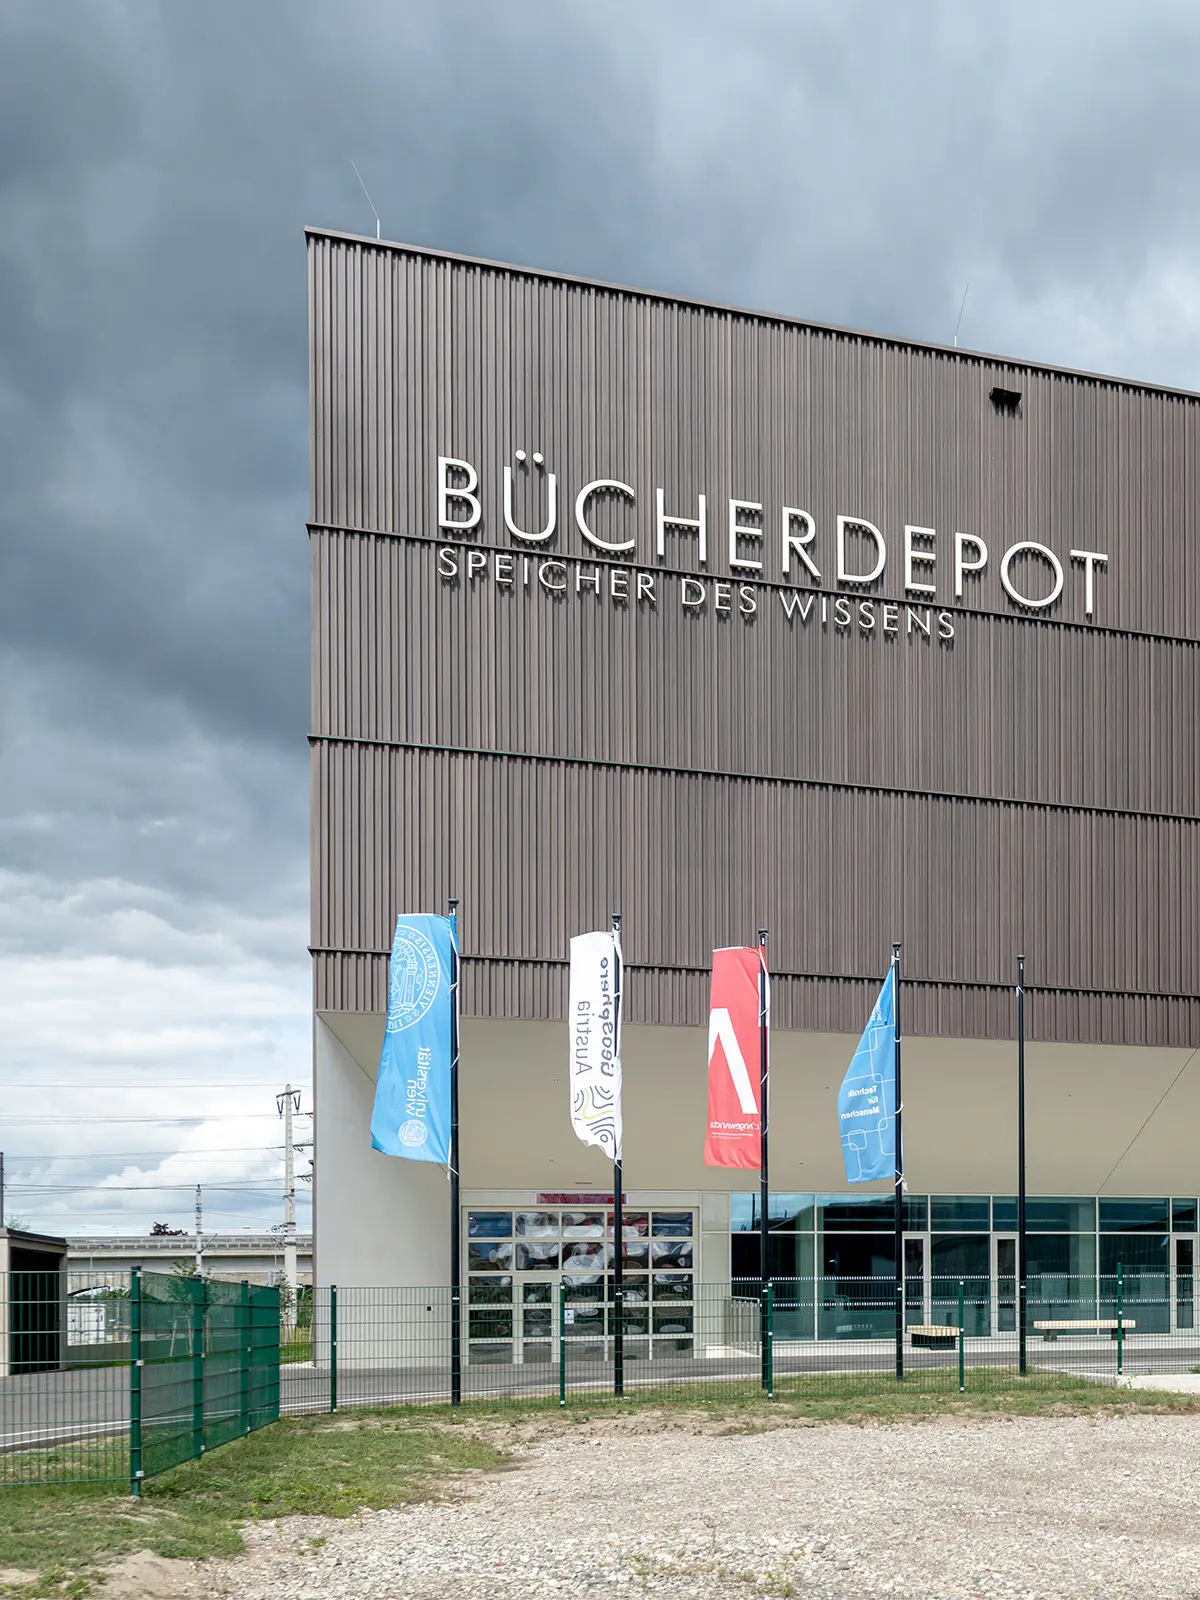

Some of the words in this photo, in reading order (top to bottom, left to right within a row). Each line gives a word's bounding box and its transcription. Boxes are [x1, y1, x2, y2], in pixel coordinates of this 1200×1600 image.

[437, 449, 1108, 616] BÜCHERDEPOT
[437, 548, 657, 602] SPEICHER
[681, 578, 757, 614] DES
[780, 592, 956, 640] WISSENS
